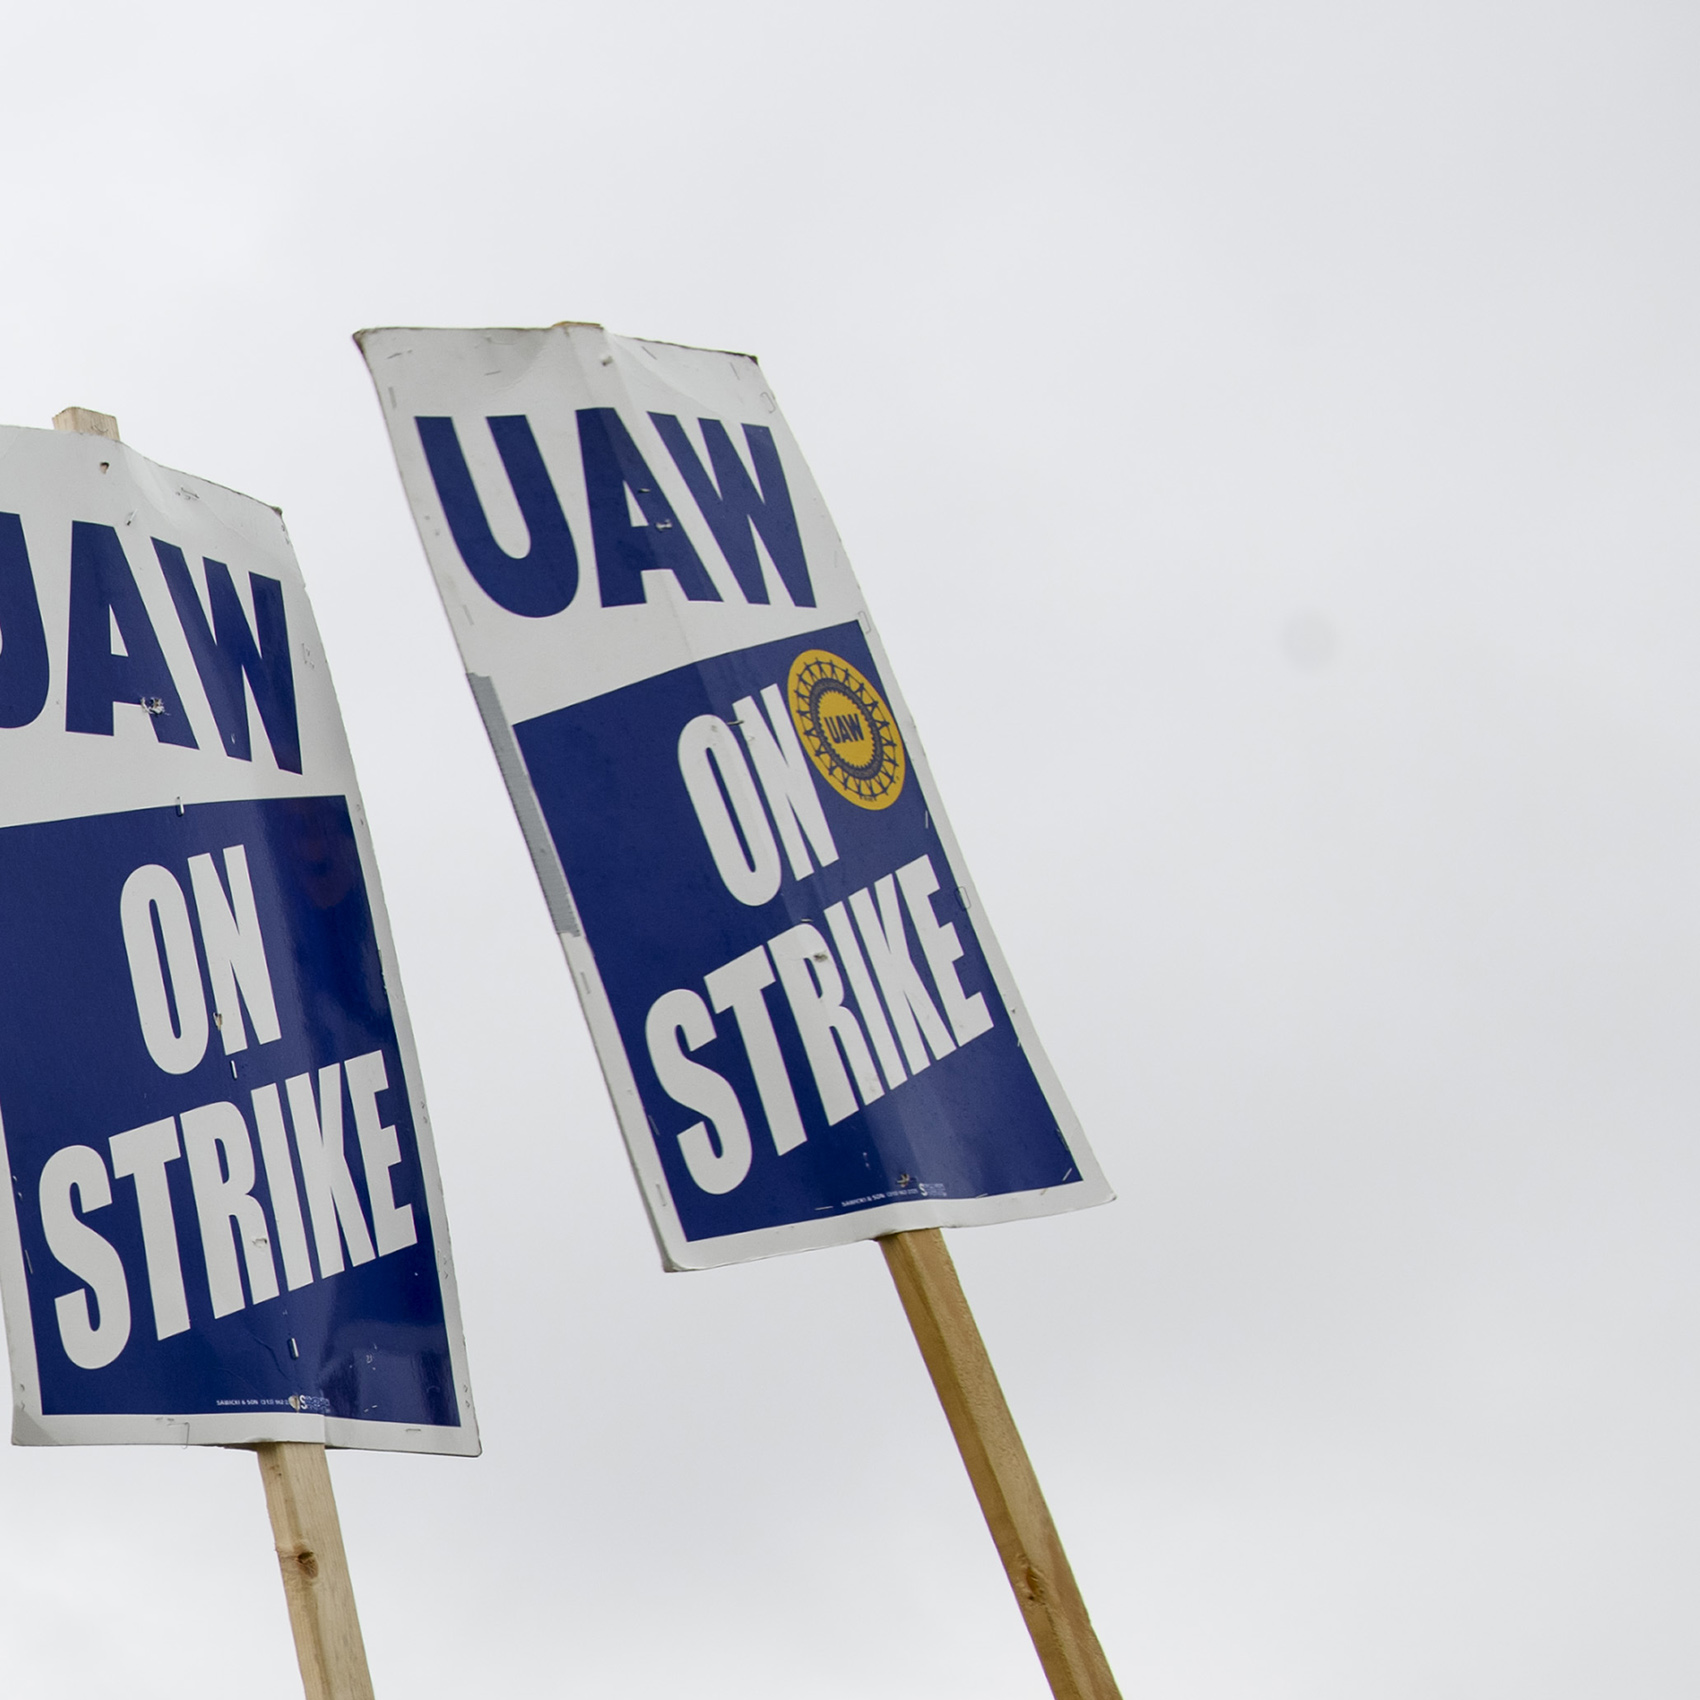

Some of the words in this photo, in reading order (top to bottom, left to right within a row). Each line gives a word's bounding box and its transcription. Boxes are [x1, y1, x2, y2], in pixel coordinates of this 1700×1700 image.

[414, 407, 817, 618] UAW
[677, 682, 839, 907] ON
[824, 713, 864, 744] UAW
[119, 844, 282, 1076] ON
[644, 854, 994, 1195] STRIKE
[38, 1049, 418, 1370] STRIKE
